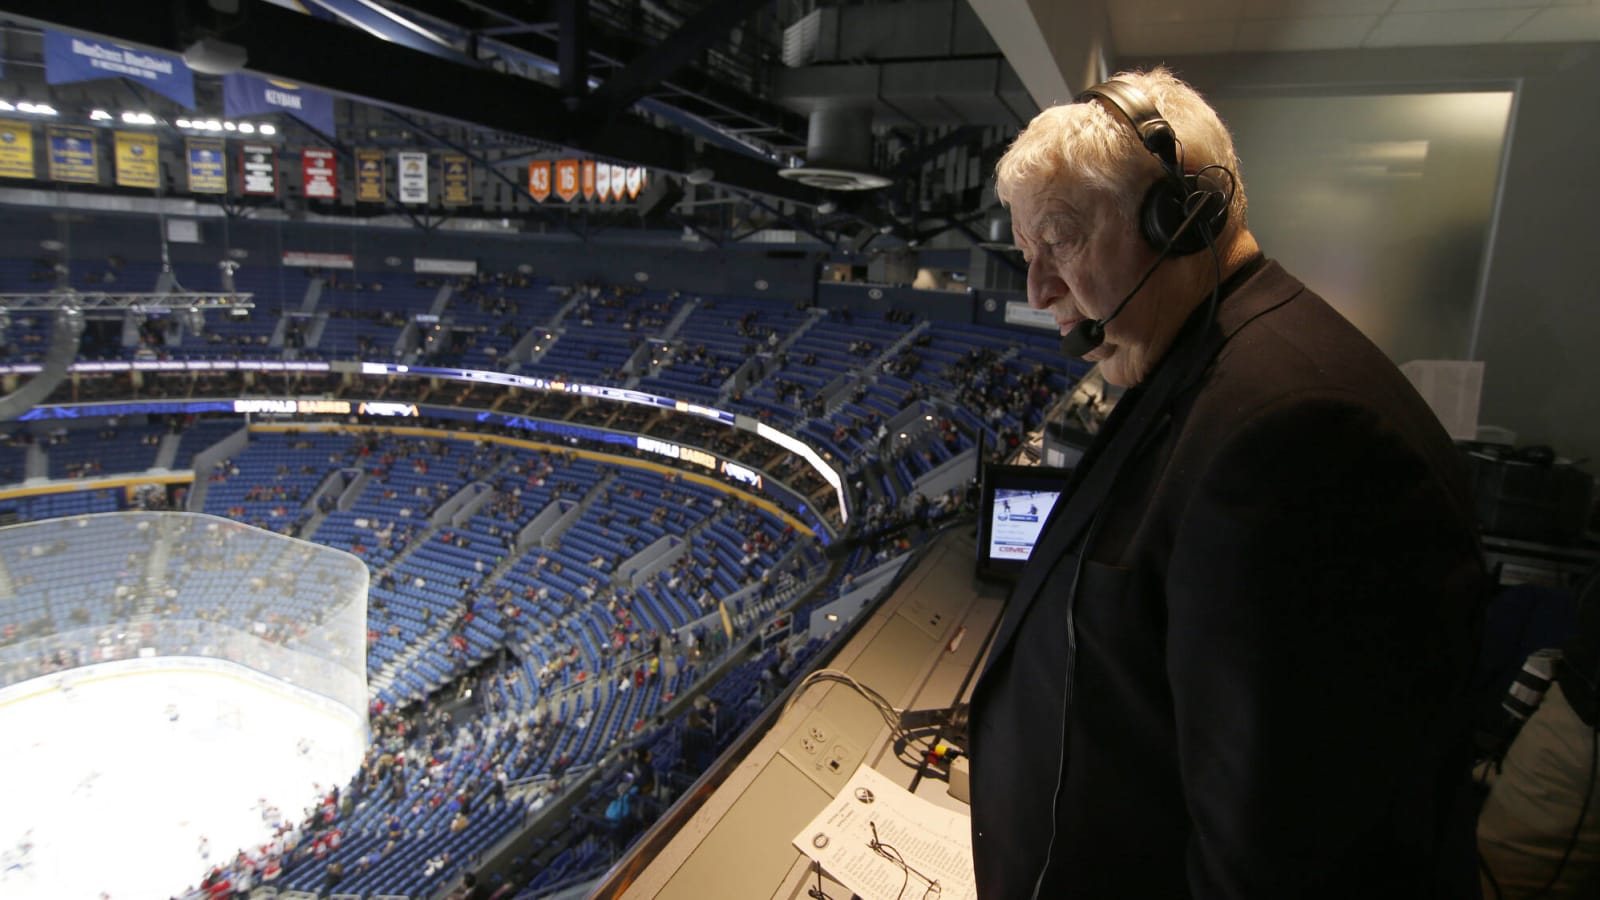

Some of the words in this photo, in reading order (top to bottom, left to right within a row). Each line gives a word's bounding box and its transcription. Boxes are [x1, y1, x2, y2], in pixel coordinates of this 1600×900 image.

[264, 88, 302, 110] KEYBANK
[532, 167, 548, 190] 43
[561, 166, 575, 190] 16
[233, 400, 297, 413] BUFFALO
[298, 400, 351, 414] SABRES
[637, 436, 679, 458] BUFFALO
[680, 447, 716, 469] SABRES
